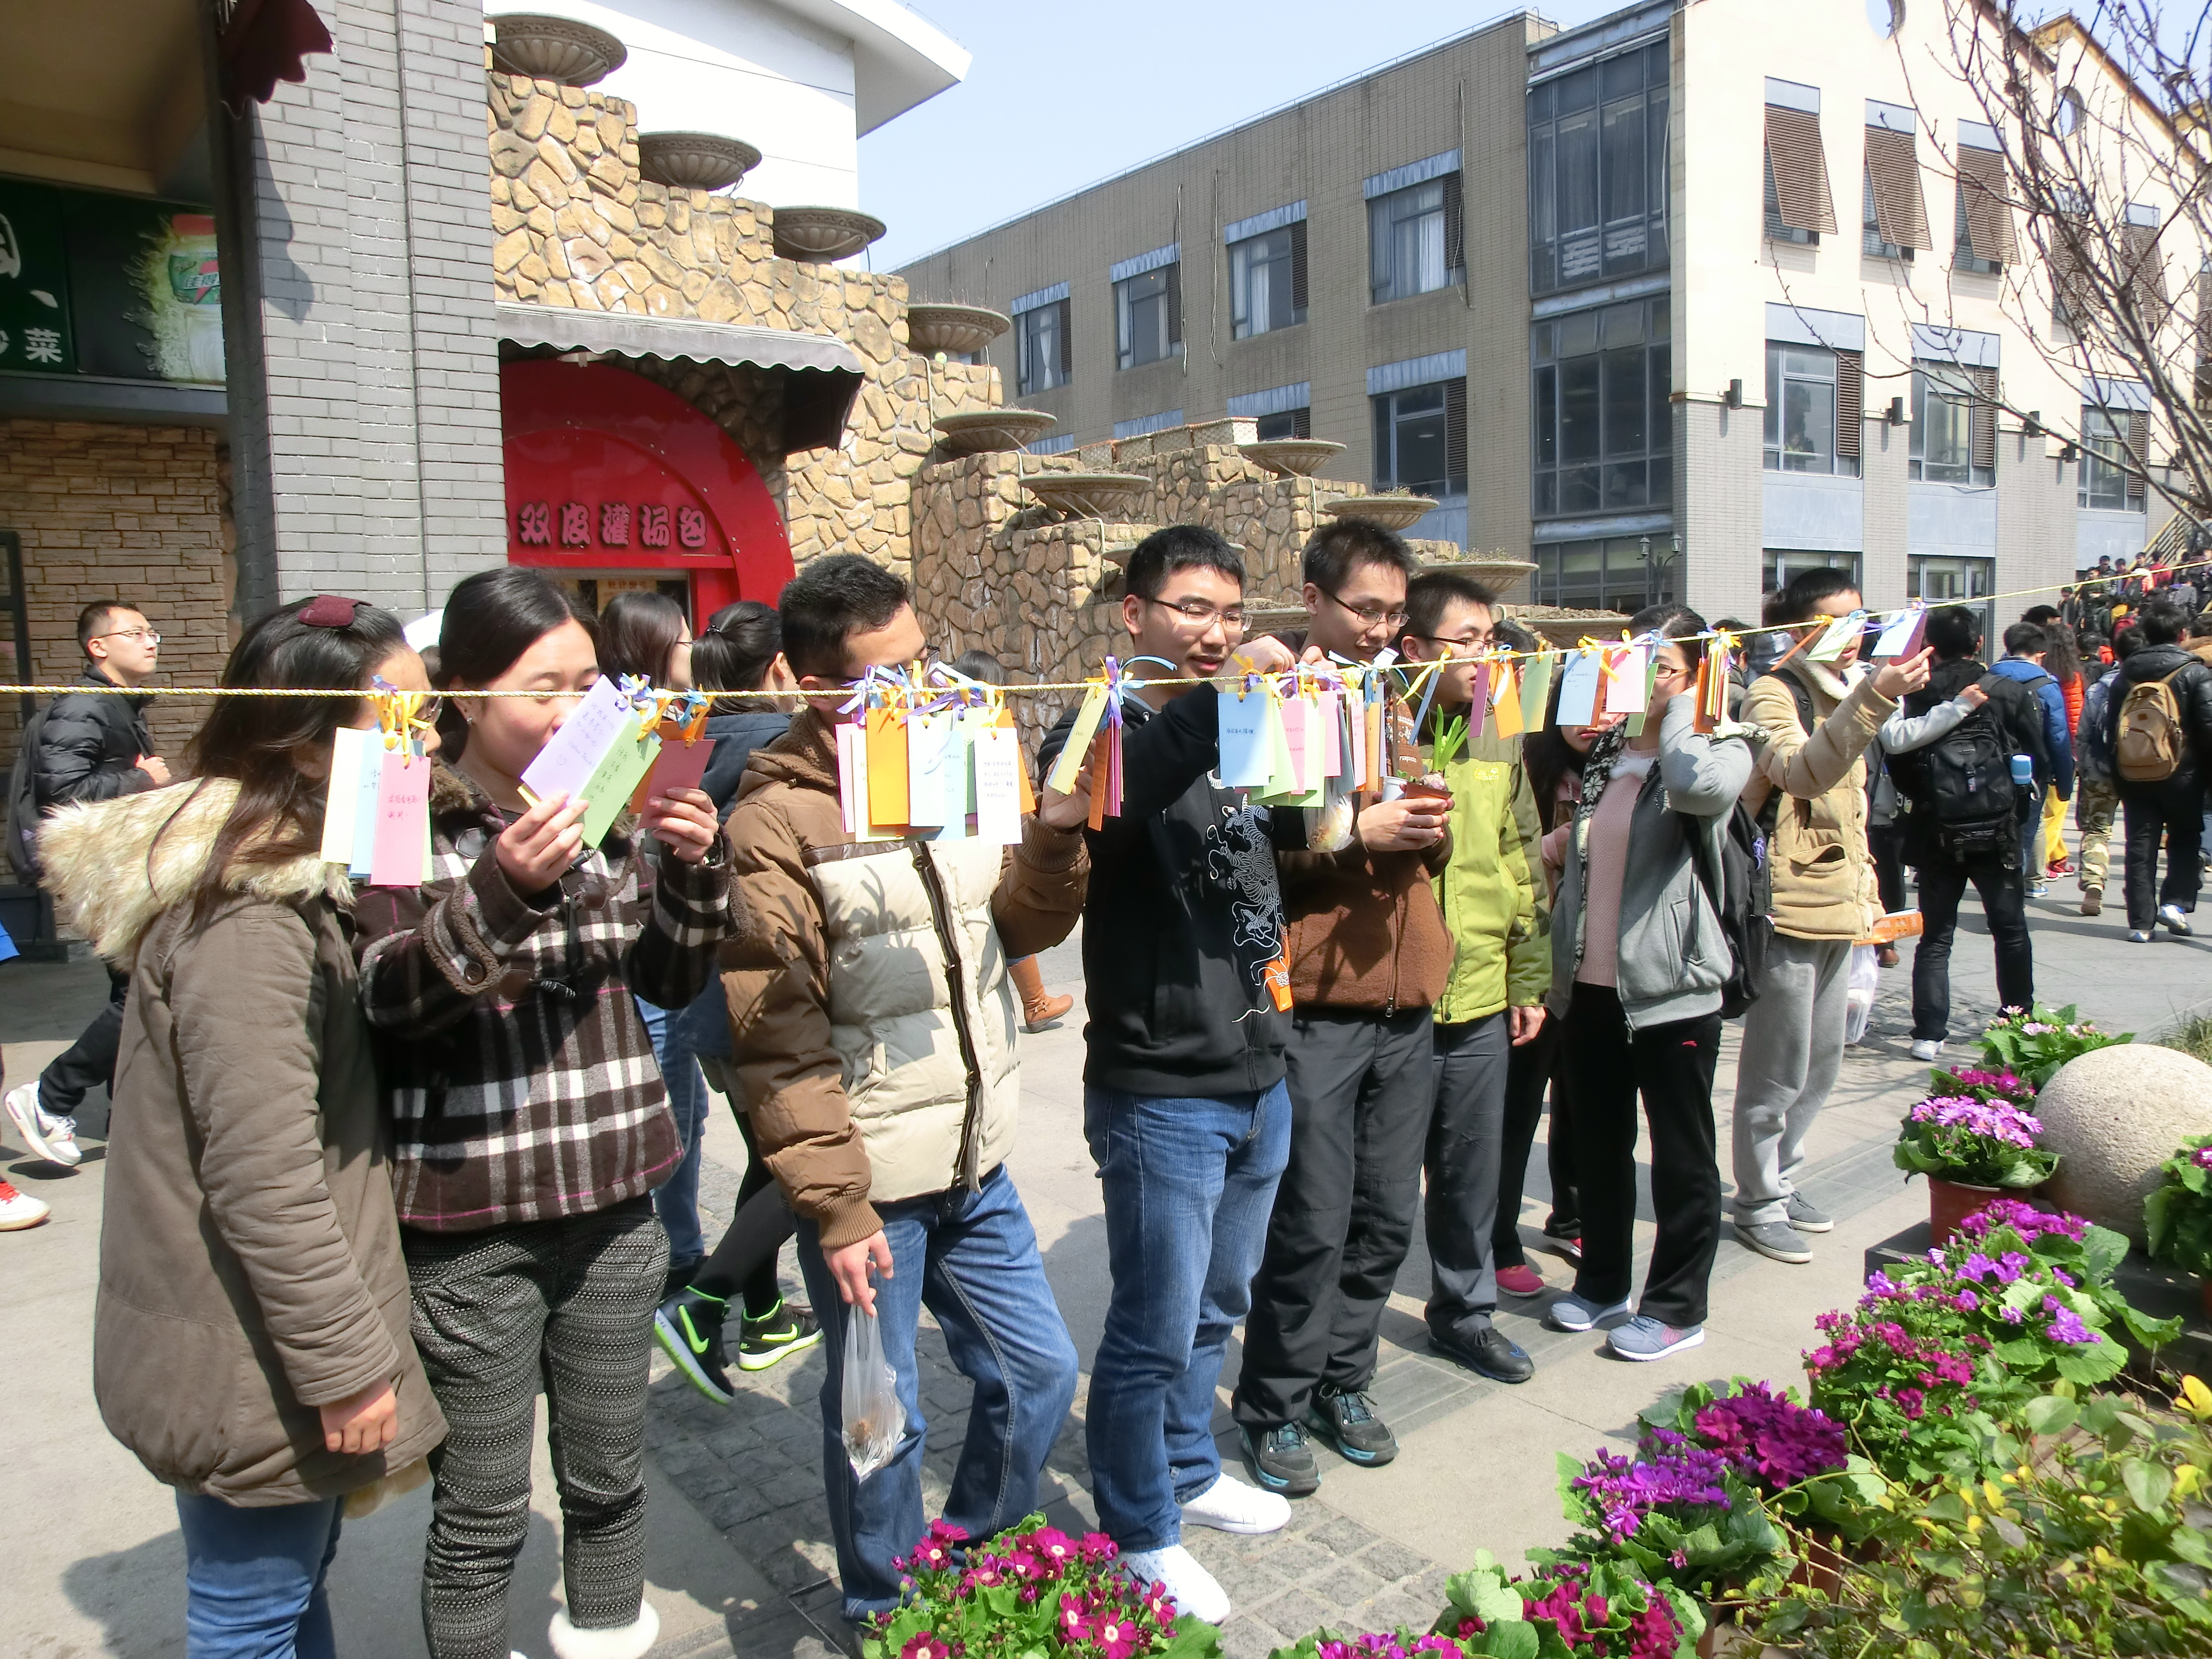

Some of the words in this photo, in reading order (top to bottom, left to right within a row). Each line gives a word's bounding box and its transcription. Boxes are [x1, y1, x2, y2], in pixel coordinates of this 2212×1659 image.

[507, 501, 706, 548] 双皮灌汤包
